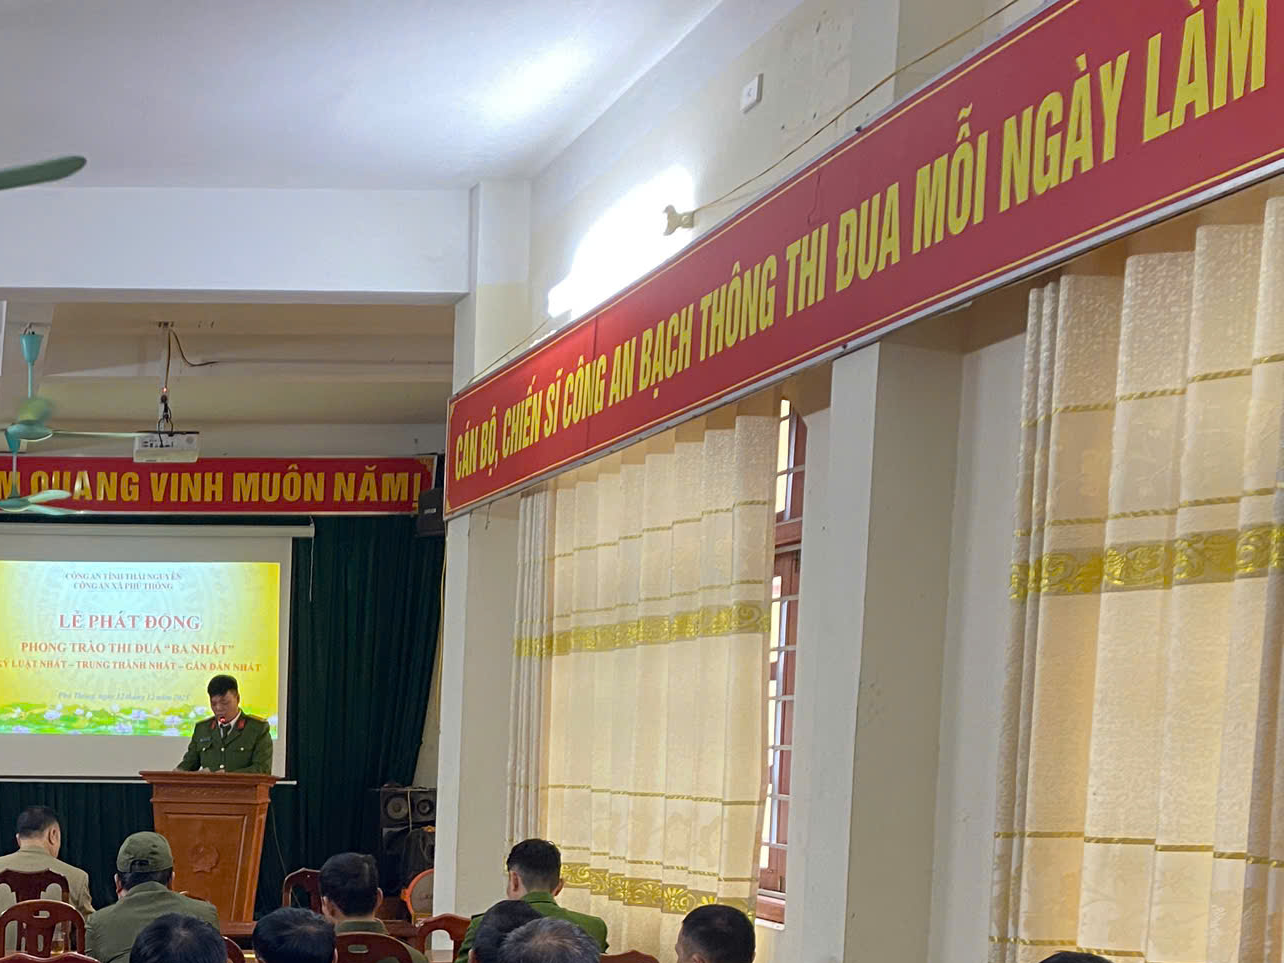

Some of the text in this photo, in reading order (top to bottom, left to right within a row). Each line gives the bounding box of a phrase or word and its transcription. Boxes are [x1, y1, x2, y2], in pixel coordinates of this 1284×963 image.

[455, 421, 479, 481] CÁN
[502, 375, 543, 458] CHIẾN
[543, 368, 564, 438] SĨ
[562, 355, 608, 429] CÔNG
[608, 337, 637, 406] AN
[638, 303, 694, 399] BẠCH
[699, 255, 777, 362] THÔNG
[786, 223, 829, 318] THI
[835, 183, 900, 292] ĐUA
[912, 103, 989, 255] MỖI
[999, 51, 1130, 213] NGÀY
[1142, 0, 1267, 143] LÀM
[150, 472, 224, 502] VINH
[233, 463, 325, 502] MUÔN
[89, 610, 141, 629] PHÁT
[144, 612, 201, 632] ĐỘNG
[21, 641, 67, 653] PHONG
[69, 639, 106, 653] TRÀO
[108, 642, 132, 654] THI
[135, 642, 162, 654] ĐUA
[76, 661, 111, 670] TRUNG
